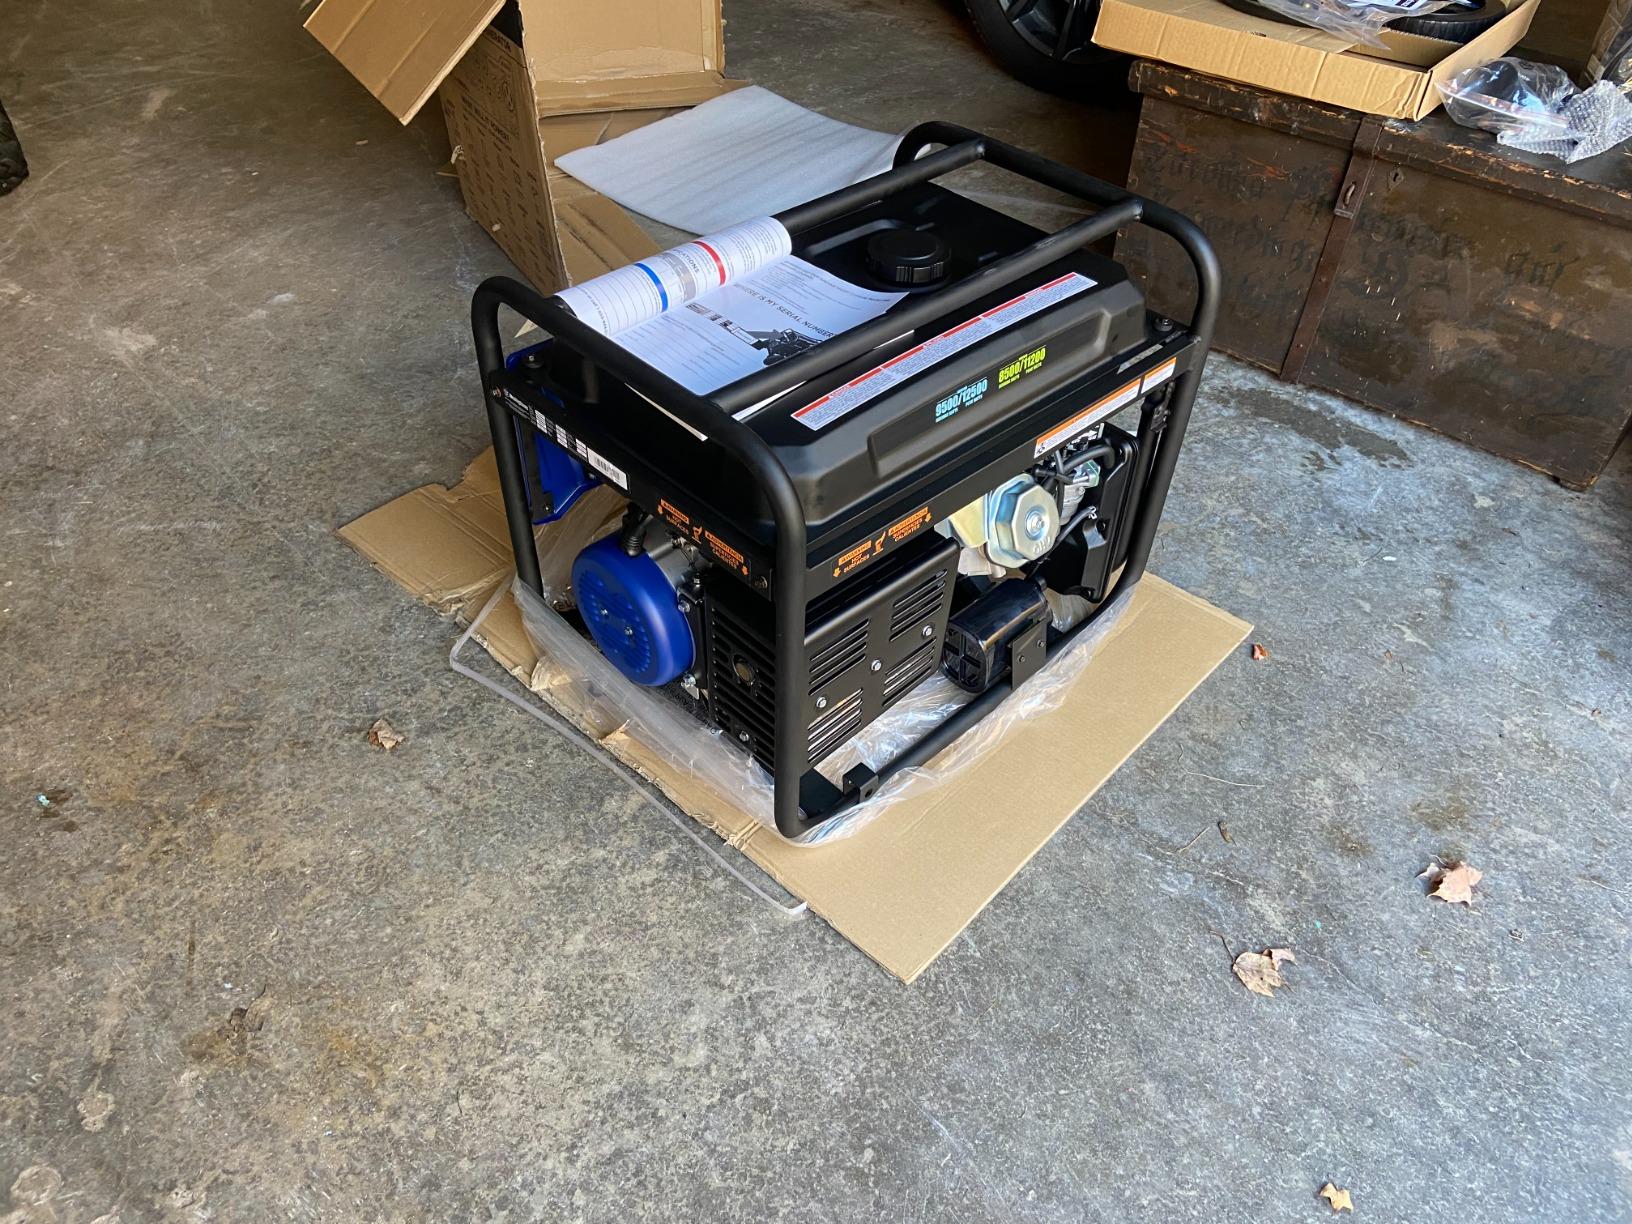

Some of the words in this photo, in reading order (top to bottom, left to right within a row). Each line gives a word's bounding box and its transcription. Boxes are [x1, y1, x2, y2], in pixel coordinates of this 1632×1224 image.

[776, 305, 801, 321] SERIAL
[801, 320, 834, 338] NUMBER
[999, 347, 1046, 383] 8500/11200
[935, 378, 988, 417] 9500/12500
